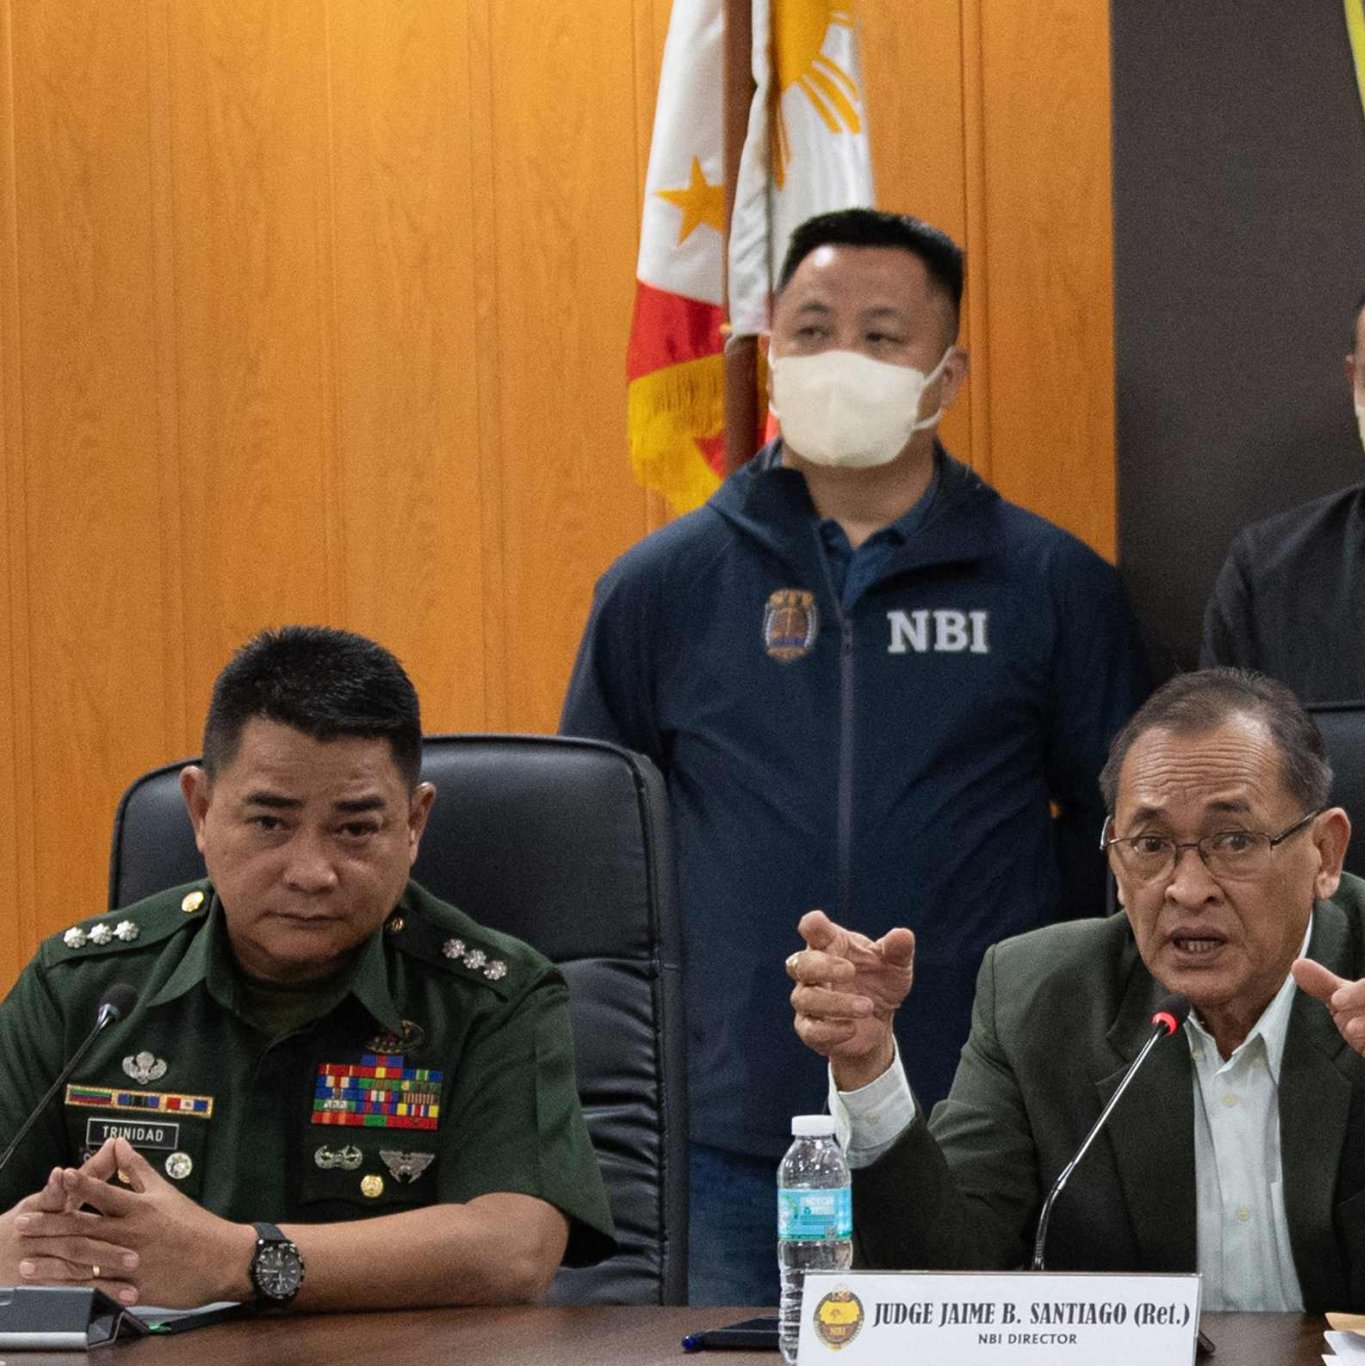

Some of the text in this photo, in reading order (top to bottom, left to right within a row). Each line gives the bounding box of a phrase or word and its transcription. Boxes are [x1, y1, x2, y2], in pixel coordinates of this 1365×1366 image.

[886, 608, 989, 655] NBI
[102, 1125, 164, 1142] TRINIDAD
[872, 1302, 1191, 1329] JUDGE JAIME B. SANTIAGO (Ret.)
[978, 1333, 1078, 1345] NBI DIRECTOR
